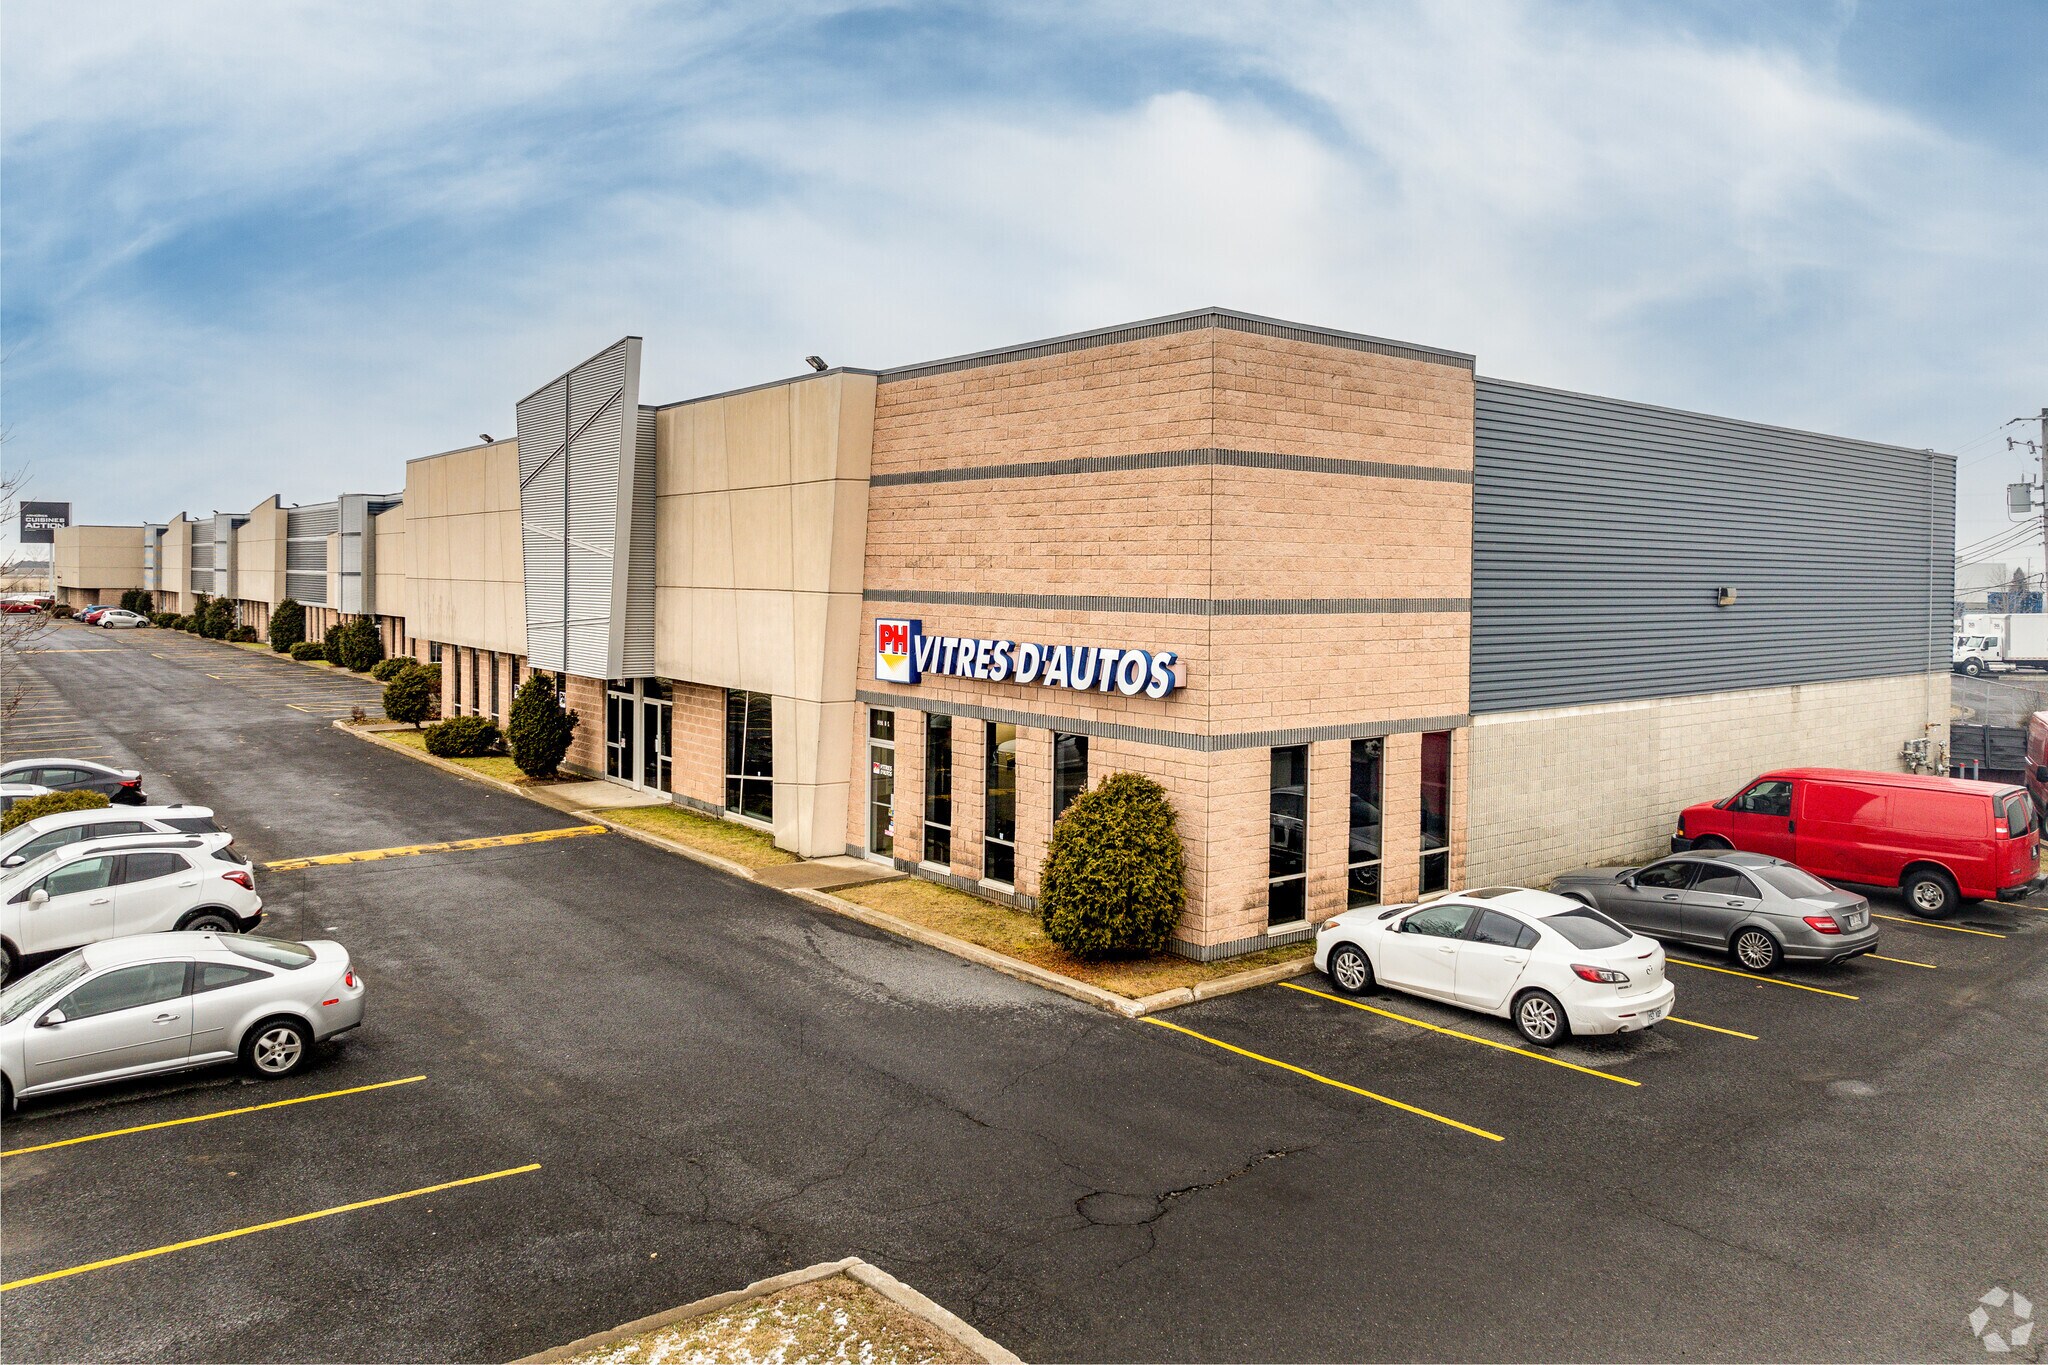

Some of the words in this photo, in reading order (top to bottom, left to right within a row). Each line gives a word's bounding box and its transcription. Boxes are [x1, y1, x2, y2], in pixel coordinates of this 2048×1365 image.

[879, 624, 908, 655] PH
[914, 635, 1013, 682] VITRES
[1015, 642, 1176, 699] D'AUTOS
